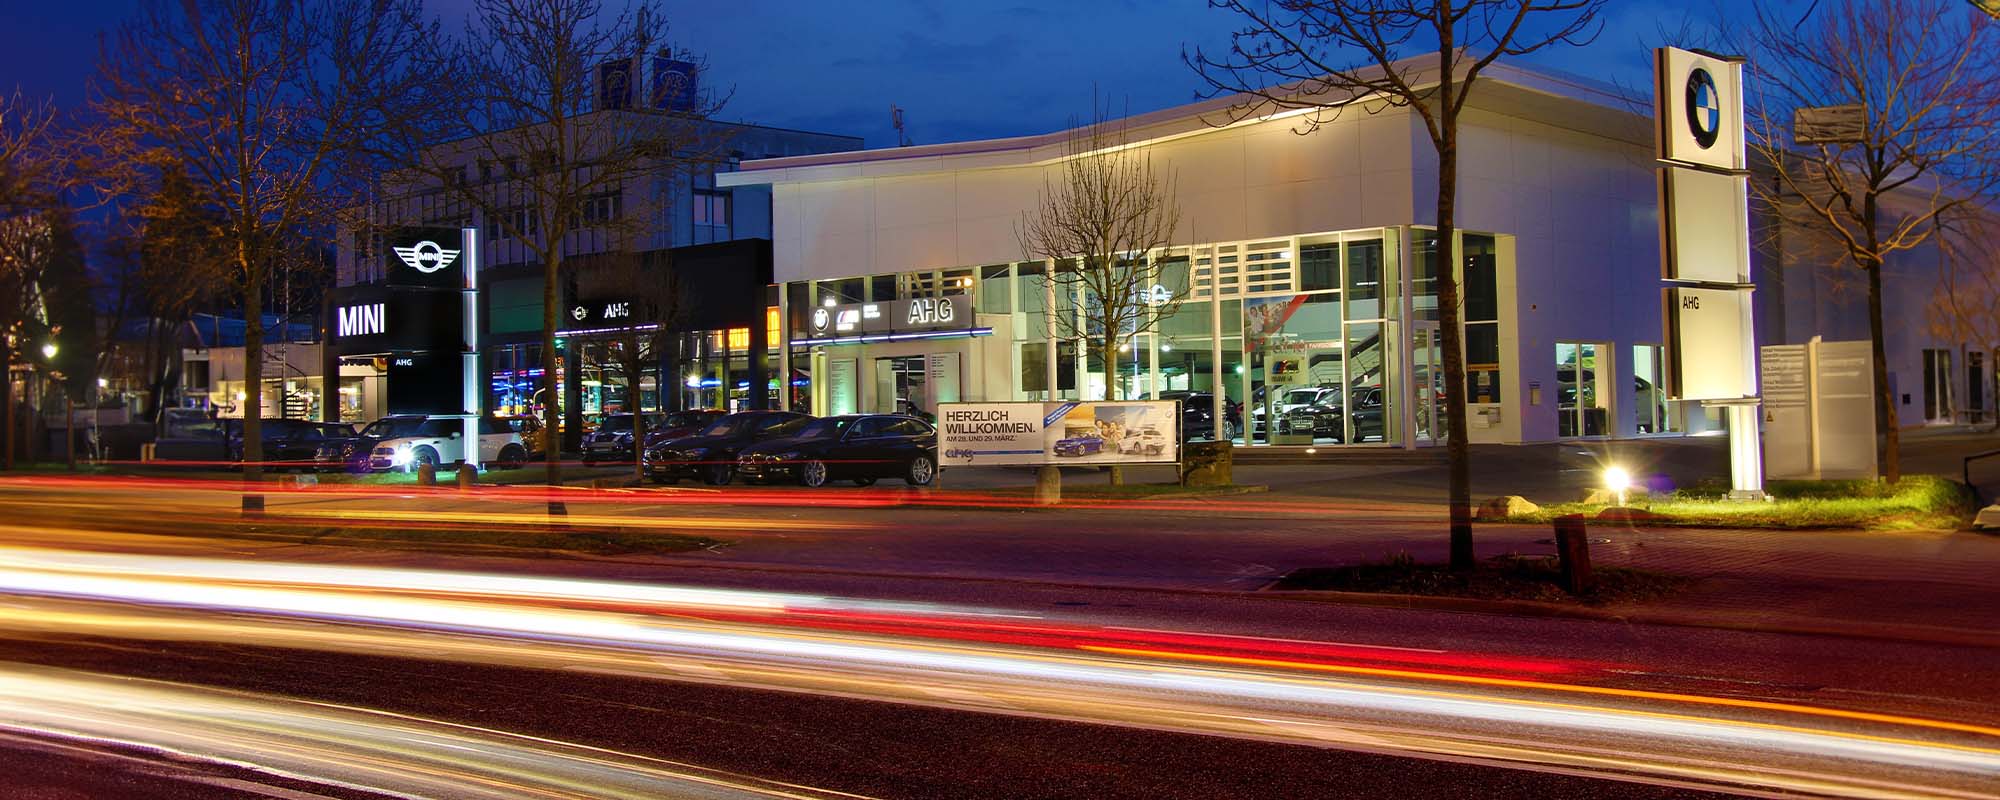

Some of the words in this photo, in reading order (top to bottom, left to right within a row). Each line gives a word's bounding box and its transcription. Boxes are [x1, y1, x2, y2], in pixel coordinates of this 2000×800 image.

[419, 252, 439, 261] MINI
[1683, 295, 1699, 310] AHG
[908, 298, 953, 324] AHG
[339, 303, 385, 337] MINI
[946, 410, 1009, 422] HERZLICH
[946, 422, 1036, 434] WILLKOMMEN.
